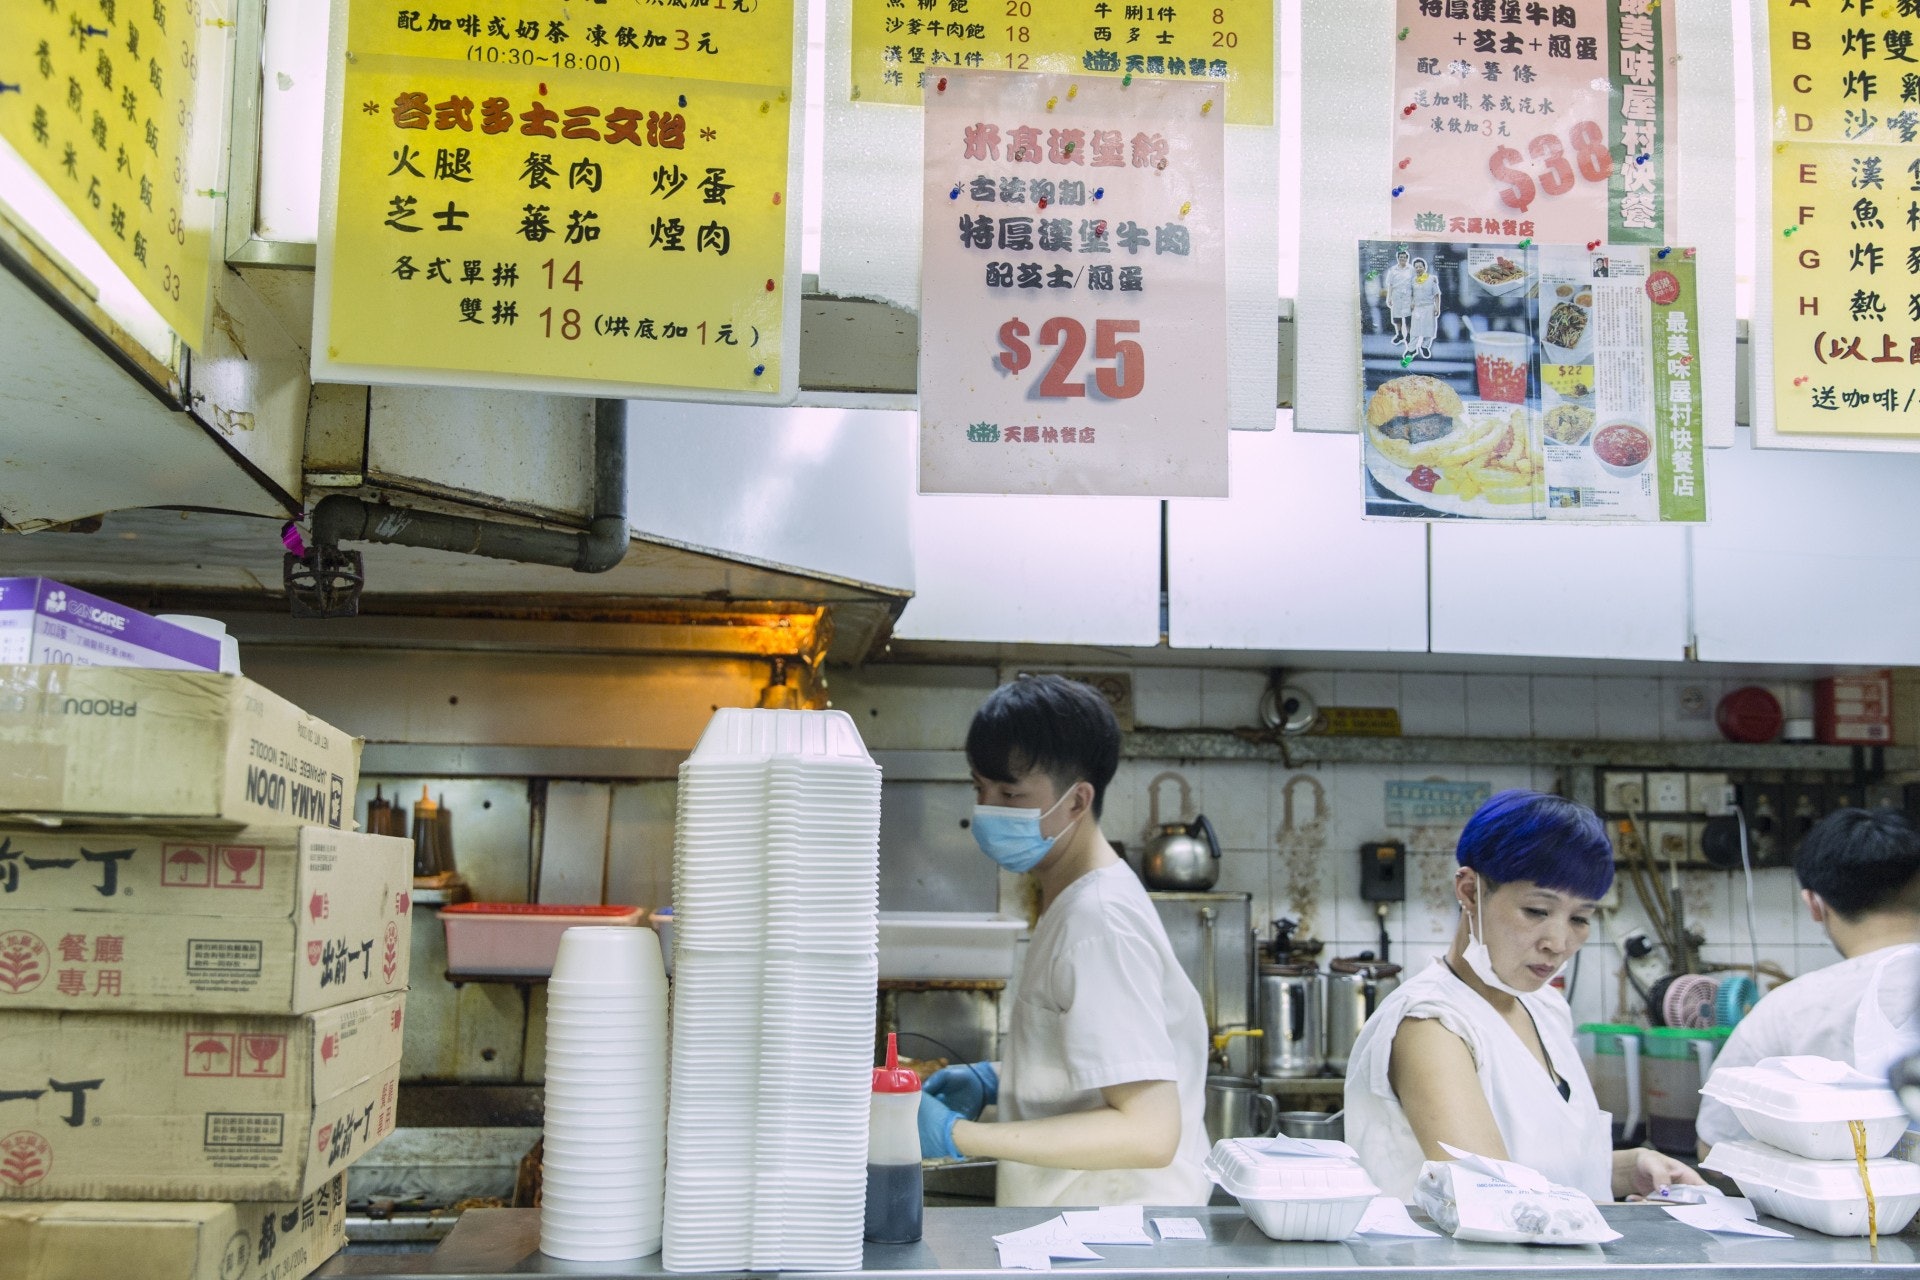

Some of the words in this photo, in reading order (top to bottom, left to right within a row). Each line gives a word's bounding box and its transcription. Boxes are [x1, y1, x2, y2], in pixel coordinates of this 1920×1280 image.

[1005, 0, 1032, 17] 20
[1212, 8, 1224, 24] 8
[1419, 0, 1577, 28] 特厚漢堡牛肉
[397, 10, 570, 46] 配加啡或奶茶
[585, 26, 719, 56] 凍飲加3元
[886, 17, 986, 40] 沙爹牛肉飽
[1005, 27, 1030, 43] 18
[1094, 26, 1175, 45] 西多士
[1212, 31, 1238, 48] 20
[1792, 31, 1812, 50] B
[1004, 53, 1030, 70] 12
[1793, 74, 1813, 94] C
[391, 91, 686, 151] 各式多士三文治
[1794, 113, 1814, 132] D
[387, 144, 475, 182] 火腿
[518, 151, 603, 193] 餐肉
[650, 164, 735, 206] 炒蛋
[1489, 121, 1614, 213] $38
[1799, 163, 1817, 184] E
[168, 207, 185, 246] 36
[384, 194, 469, 234] 芝士
[515, 203, 601, 245] 蕃茄
[649, 216, 731, 257] 煙肉
[1799, 205, 1816, 225] F
[959, 214, 1192, 256] 特厚漢堡牛肉
[390, 255, 520, 289] 各式單拼
[541, 258, 584, 292] 14
[1799, 249, 1820, 269] G
[163, 264, 180, 302] 33
[985, 262, 1144, 292] 配芝士/煎蛋
[459, 297, 520, 327] 雙拼
[539, 306, 582, 341] 18
[1799, 297, 1818, 316] H
[999, 316, 1145, 400] $25
[1558, 365, 1582, 377] $22
[1665, 311, 1694, 497] 最美味屋村快餐店
[68, 600, 125, 631] CANCARE
[44, 647, 73, 665] 100
[250, 738, 278, 765] NOODLE
[279, 751, 298, 773] STYLE
[299, 760, 327, 785] JAPANESE
[246, 764, 286, 812] UDON
[291, 780, 326, 824] NAMA
[58, 932, 125, 963] 餐廳
[320, 935, 375, 988] 出前一丁
[57, 968, 122, 997] 專用
[327, 1101, 375, 1168] 出前一丁
